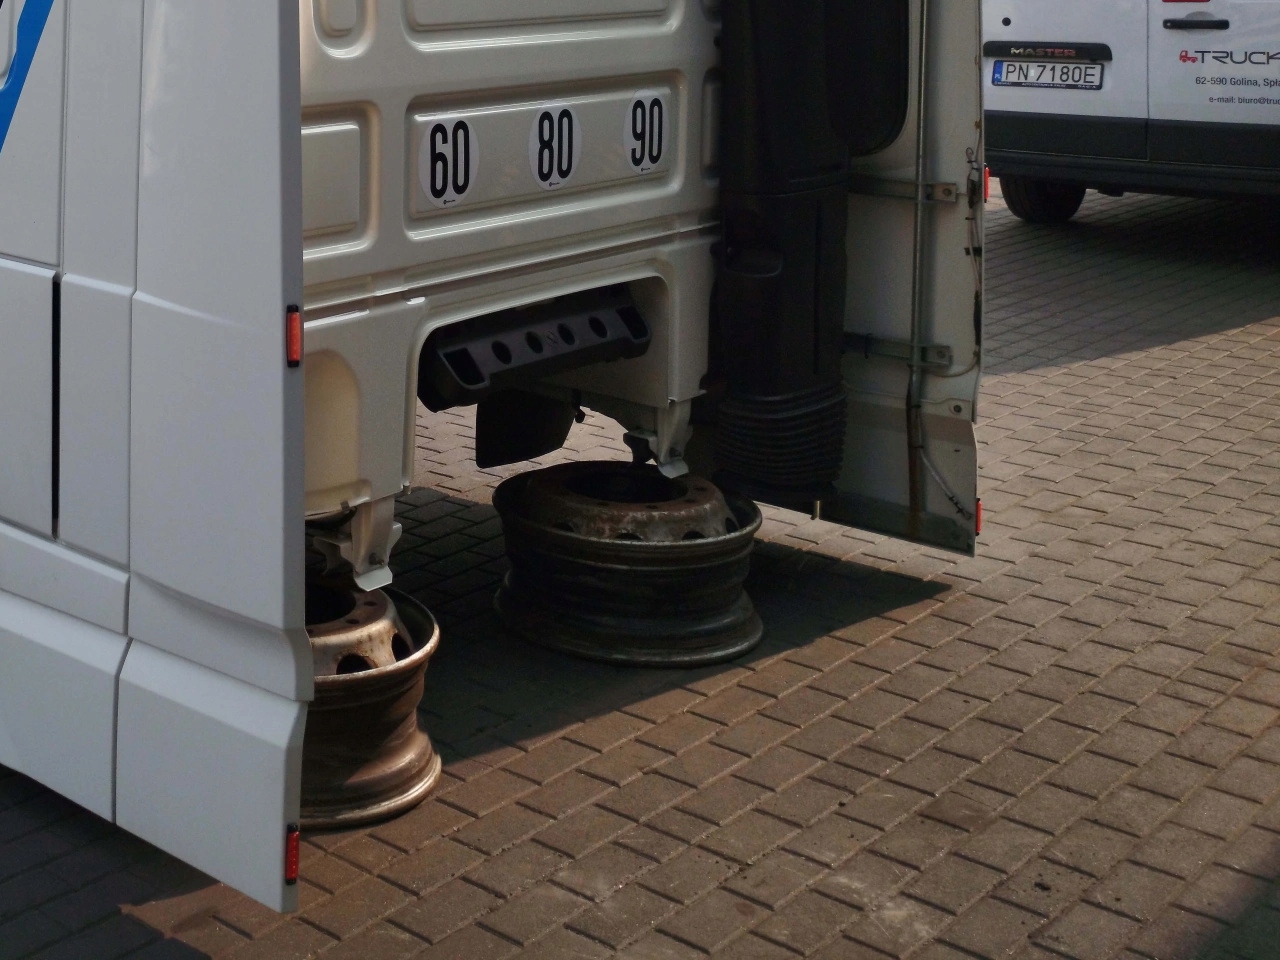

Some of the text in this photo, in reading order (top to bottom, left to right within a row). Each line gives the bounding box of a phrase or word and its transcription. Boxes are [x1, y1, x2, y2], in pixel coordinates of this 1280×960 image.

[1010, 47, 1077, 57] MASTER
[1005, 63, 1029, 81] PN
[1036, 64, 1096, 84] 7180E
[1195, 76, 1227, 85] 62-590
[1230, 77, 1261, 88] Golina,
[1209, 96, 1236, 104] e-mail:
[631, 97, 663, 167] 90
[537, 108, 574, 182] 80
[429, 120, 470, 199] 60
